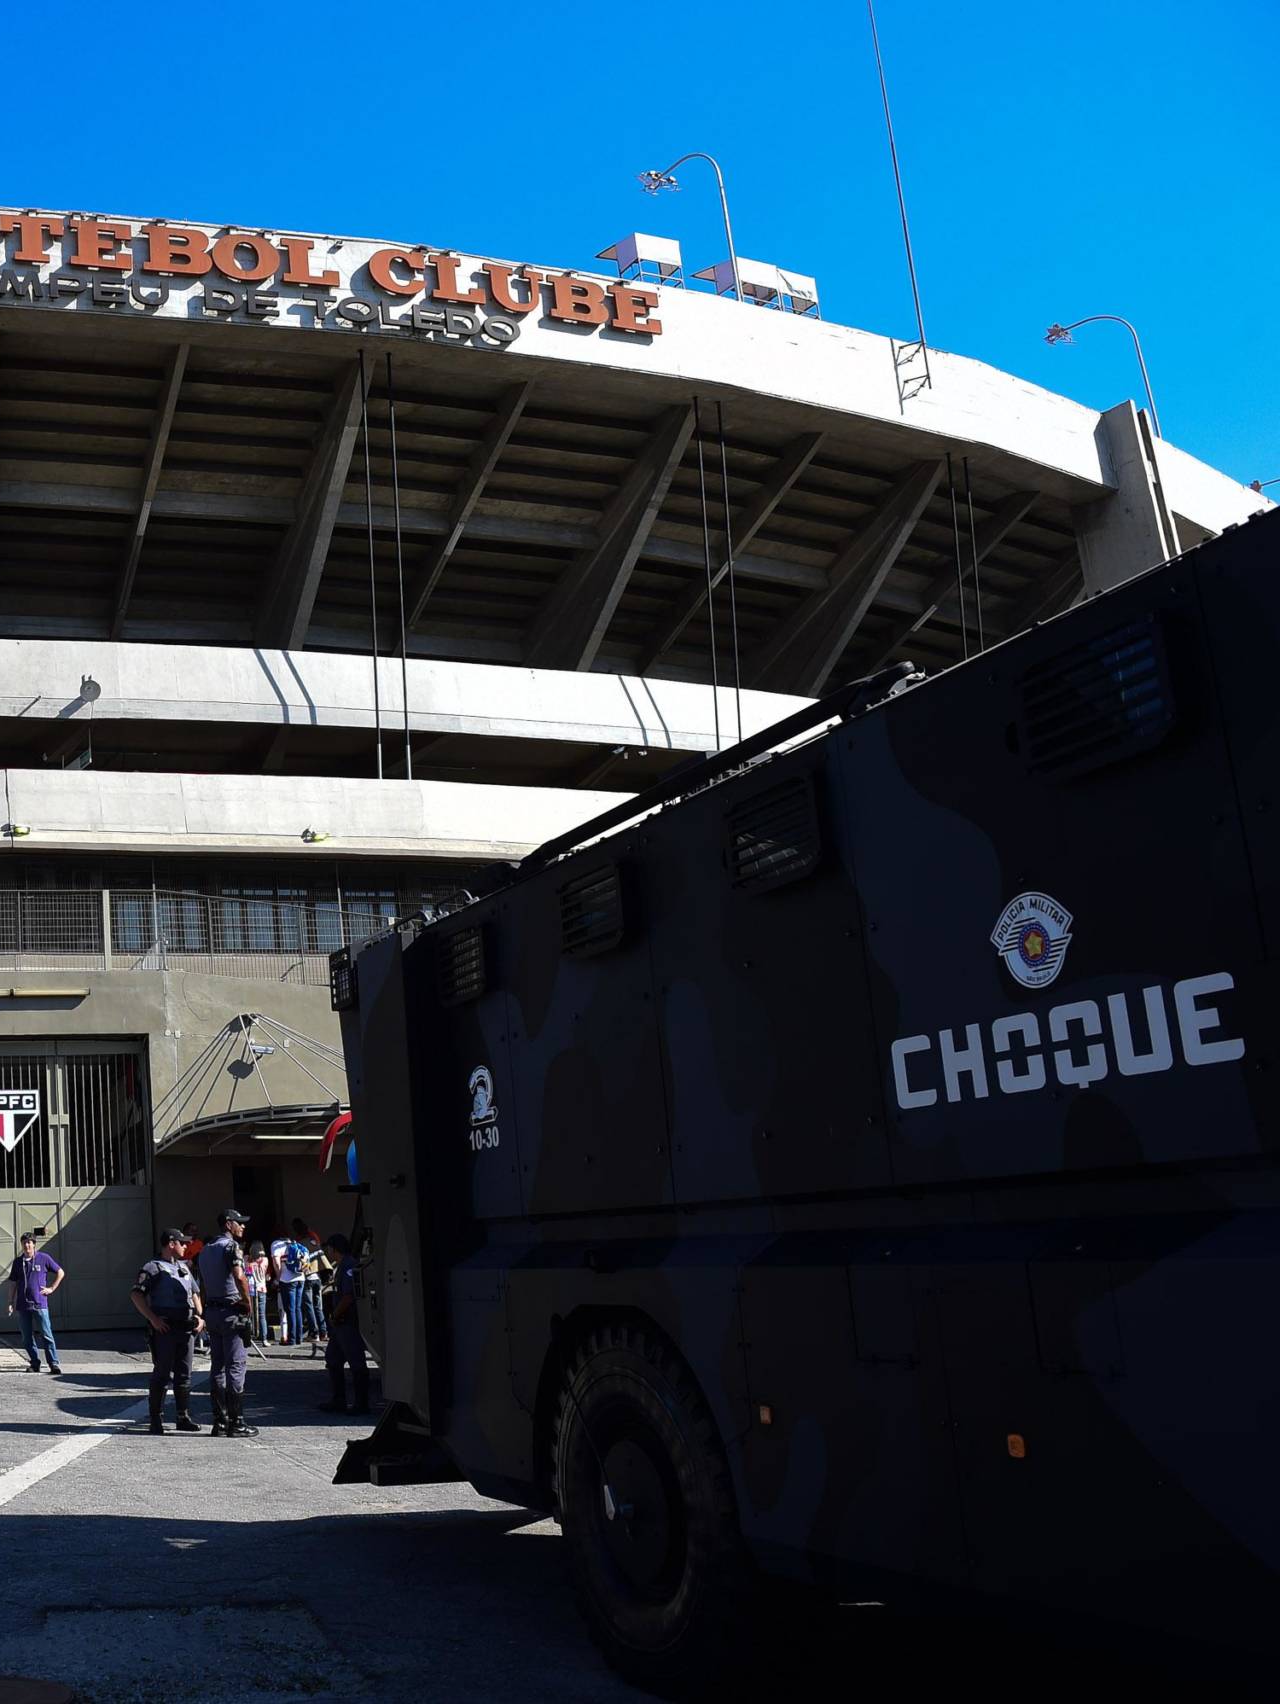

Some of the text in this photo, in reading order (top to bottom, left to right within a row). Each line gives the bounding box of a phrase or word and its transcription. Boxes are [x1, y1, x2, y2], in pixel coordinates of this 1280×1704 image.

[204, 281, 280, 318] DE
[302, 293, 522, 343] TOLEDO
[368, 248, 663, 336] CLUBE
[1029, 898, 1066, 927] MILITAR
[891, 972, 1246, 1110] CHOQUE
[469, 1126, 500, 1151] 10-30
